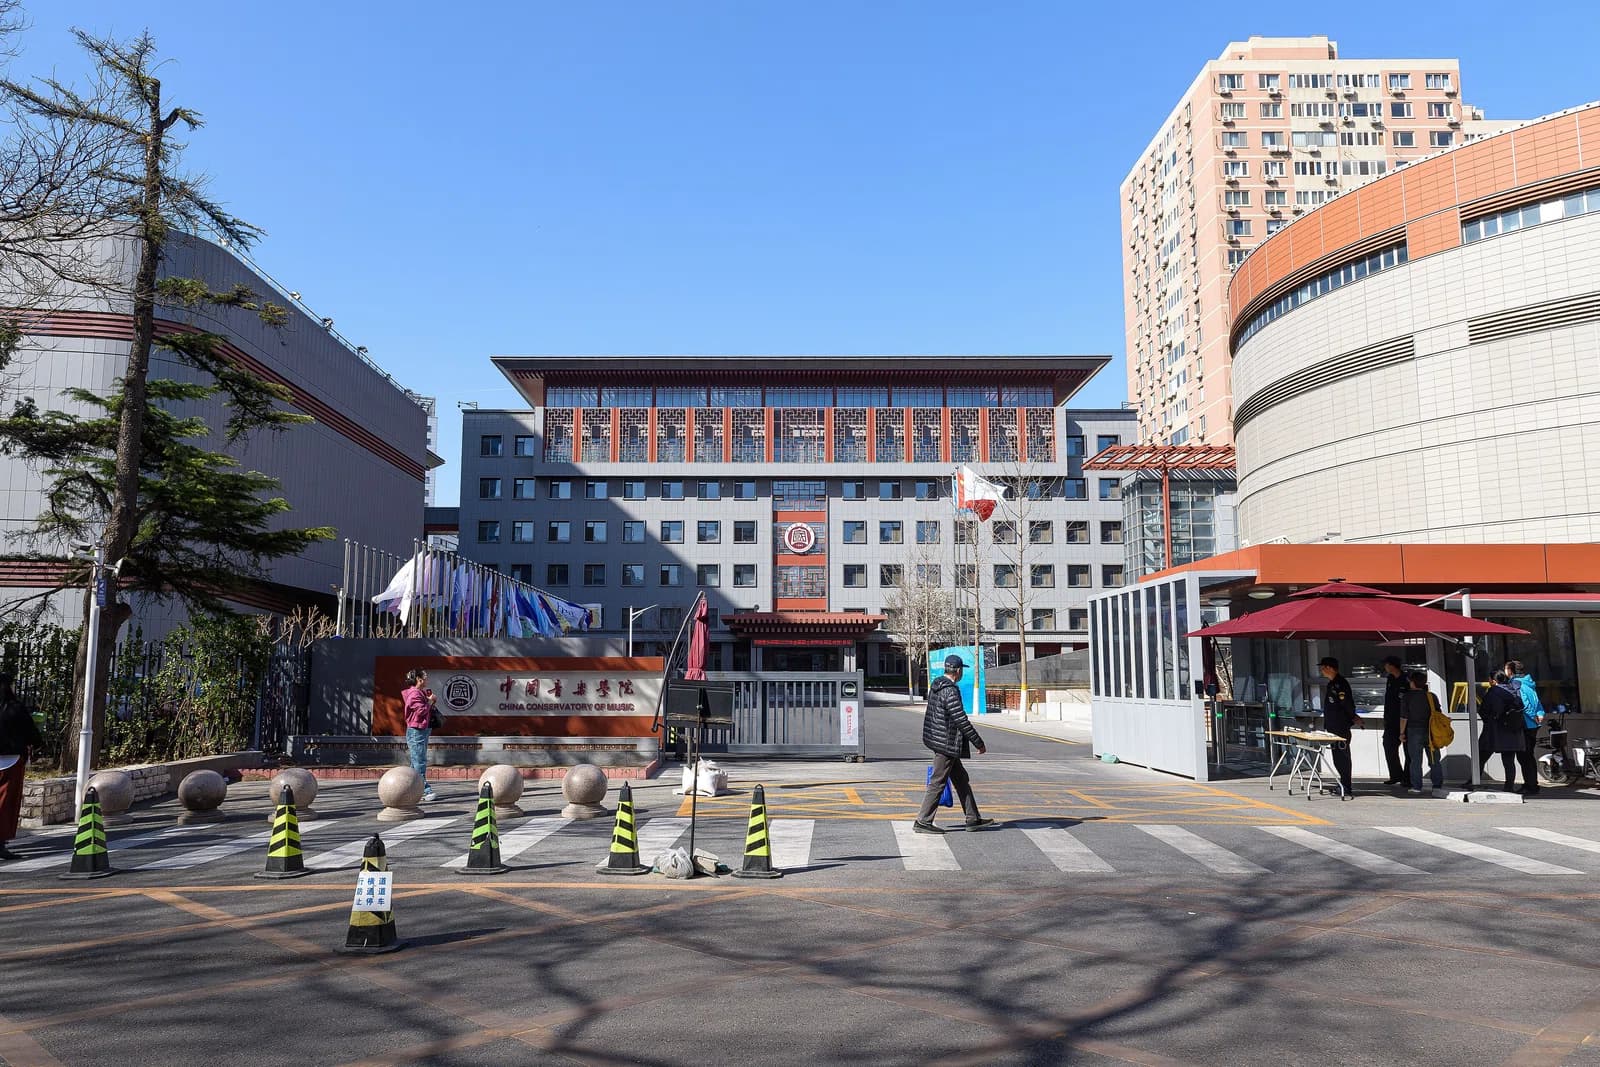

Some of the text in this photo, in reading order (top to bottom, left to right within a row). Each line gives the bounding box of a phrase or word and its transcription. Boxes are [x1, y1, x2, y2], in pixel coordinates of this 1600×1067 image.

[499, 703, 635, 712] CHINA CONSERVATORY OF MUSIC
